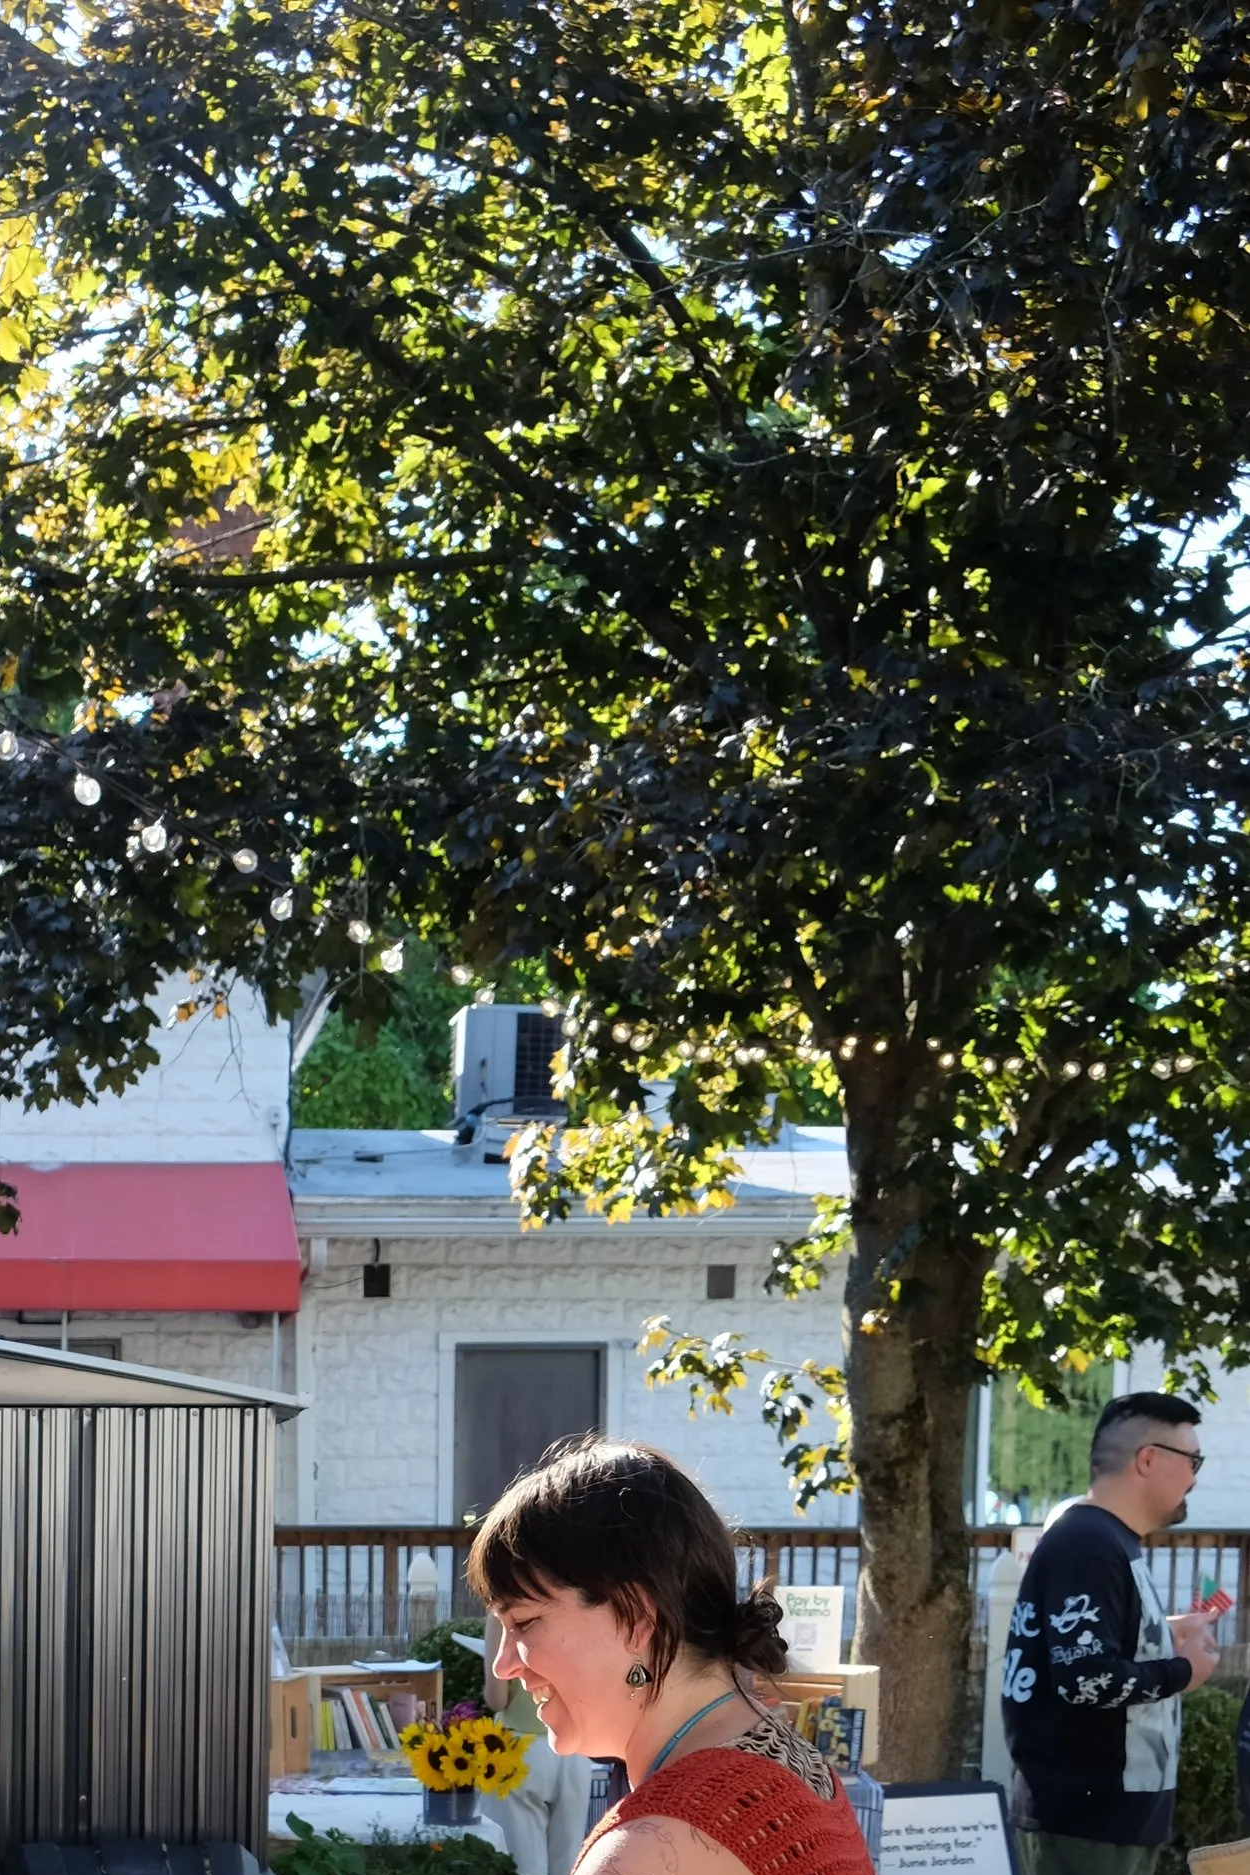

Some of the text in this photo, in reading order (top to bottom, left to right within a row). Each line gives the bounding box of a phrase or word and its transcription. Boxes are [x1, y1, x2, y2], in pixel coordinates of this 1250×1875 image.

[905, 1824, 925, 1835] the
[928, 1825, 957, 1834] ones
[903, 1840, 951, 1852] waiting
[898, 1858, 928, 1868] June
[930, 1855, 975, 1867] Jordan
